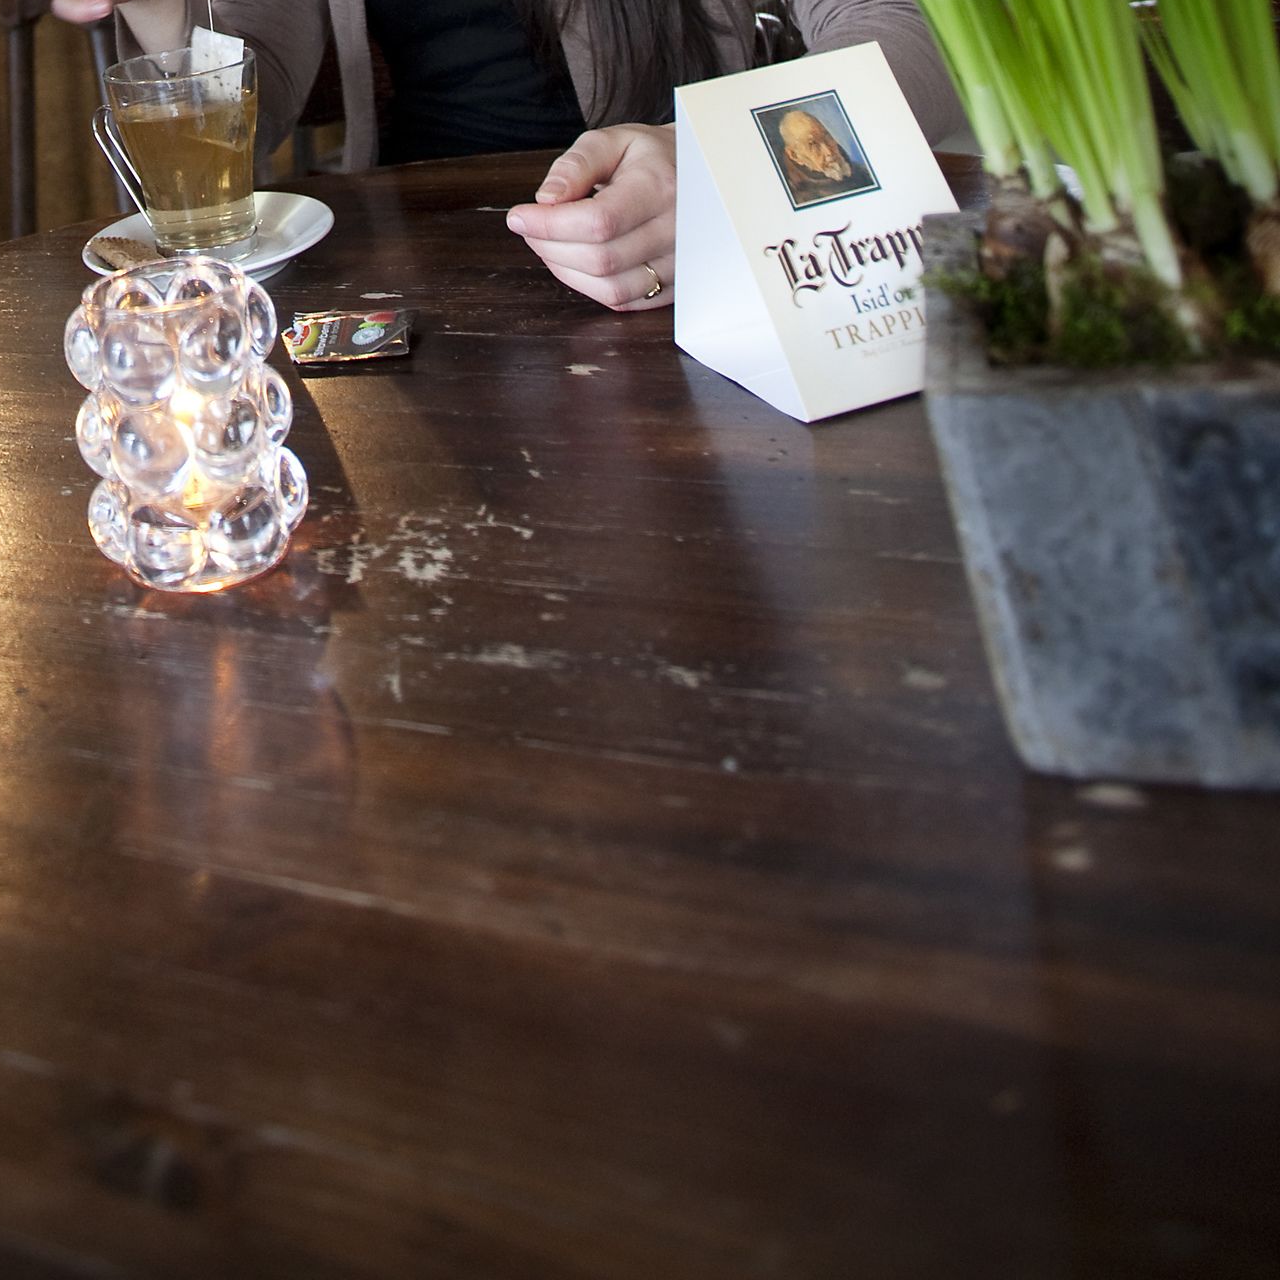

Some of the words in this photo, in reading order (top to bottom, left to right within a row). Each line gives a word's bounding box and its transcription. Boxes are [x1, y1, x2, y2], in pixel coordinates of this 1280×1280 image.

[763, 237, 828, 309] La
[812, 220, 923, 288] Trapp
[825, 306, 927, 350] TRAPPI
